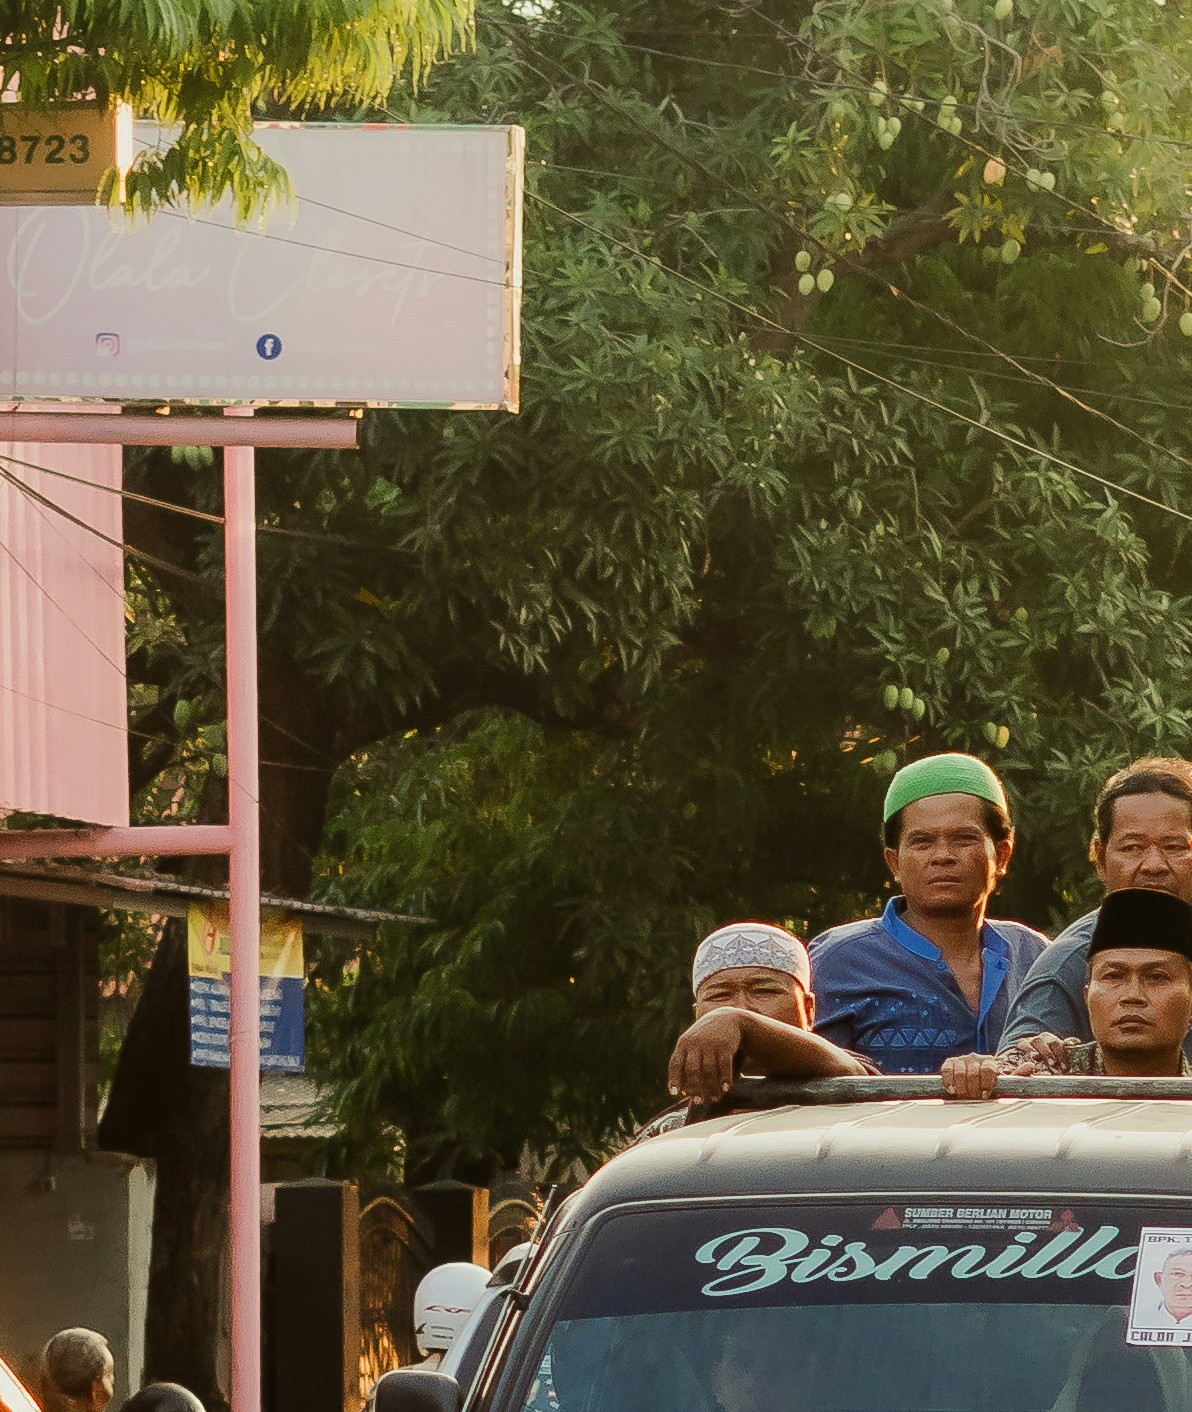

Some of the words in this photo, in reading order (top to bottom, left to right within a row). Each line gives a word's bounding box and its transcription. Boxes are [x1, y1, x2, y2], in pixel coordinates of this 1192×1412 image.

[904, 1207, 954, 1218] SUMBER
[956, 1208, 1007, 1219] BERLIAN
[1009, 1208, 1052, 1220] MOTOR
[1131, 1331, 1175, 1342] CALON
